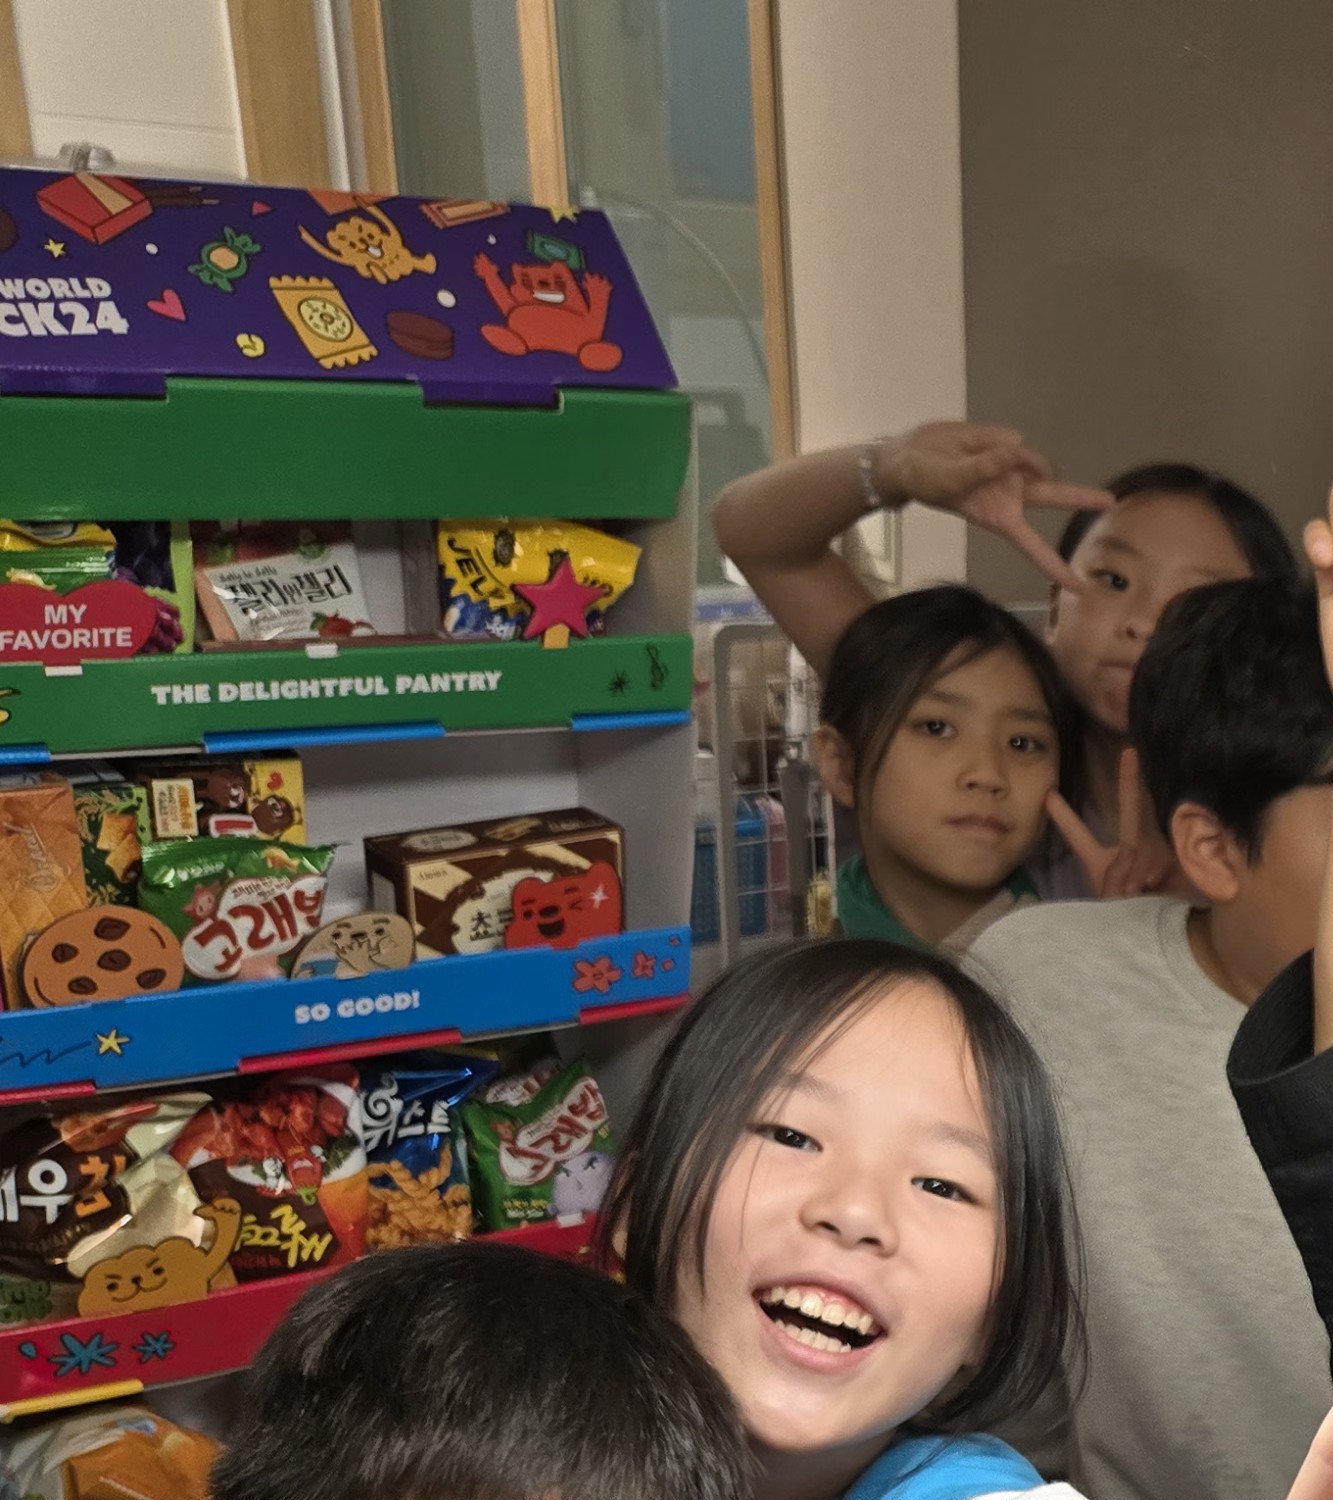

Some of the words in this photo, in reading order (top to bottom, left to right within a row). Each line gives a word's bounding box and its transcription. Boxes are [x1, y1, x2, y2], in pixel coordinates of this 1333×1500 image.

[0, 277, 112, 299] WORLD
[44, 603, 87, 626] MY
[0, 626, 133, 651] FAVORITE
[151, 683, 211, 706] THE
[218, 674, 389, 703] DELIGHTFUL
[396, 669, 502, 695] PANTRY
[294, 1001, 332, 1025] SO
[336, 988, 421, 1018] GOOD!
